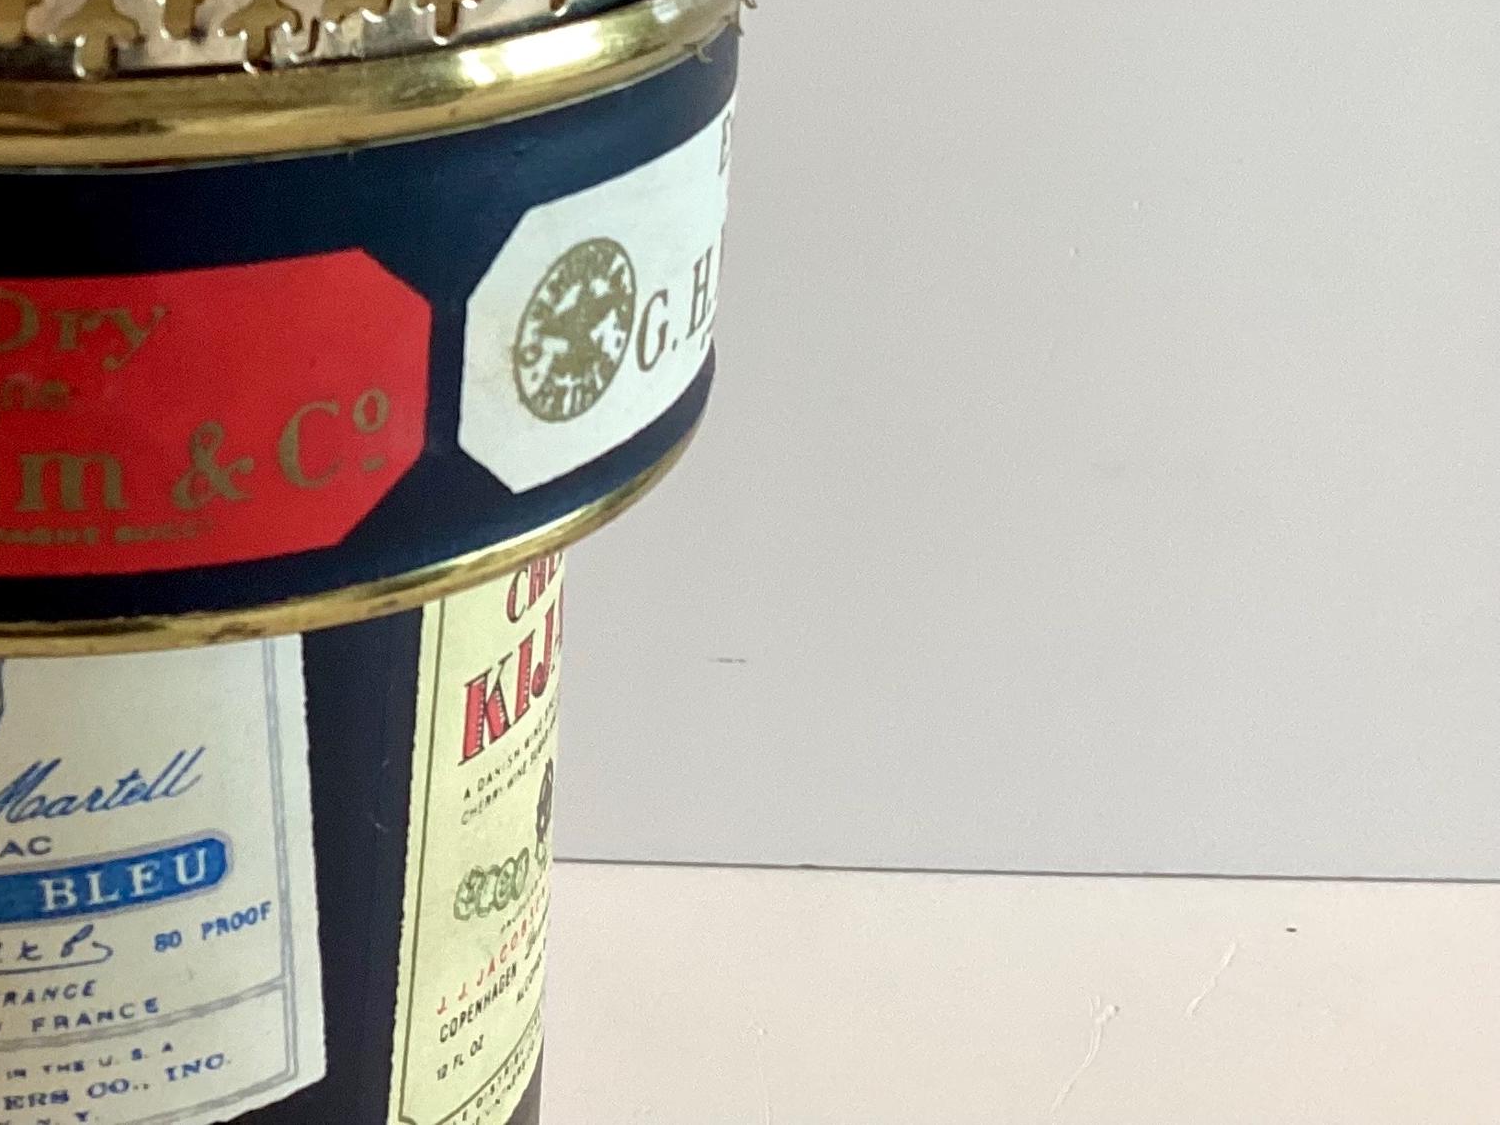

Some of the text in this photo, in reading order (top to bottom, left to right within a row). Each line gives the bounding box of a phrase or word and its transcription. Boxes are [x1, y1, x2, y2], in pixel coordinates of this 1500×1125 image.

[172, 421, 254, 511] &
[39, 847, 210, 912] BLEU
[154, 900, 272, 954] 80 PROOF
[32, 997, 160, 1033] FRANCE
[439, 961, 518, 1044] COPENHAGEN
[6, 1068, 27, 1081] IN
[43, 1060, 86, 1074] THE
[453, 1053, 465, 1071] FL
[470, 1033, 485, 1058] OZ
